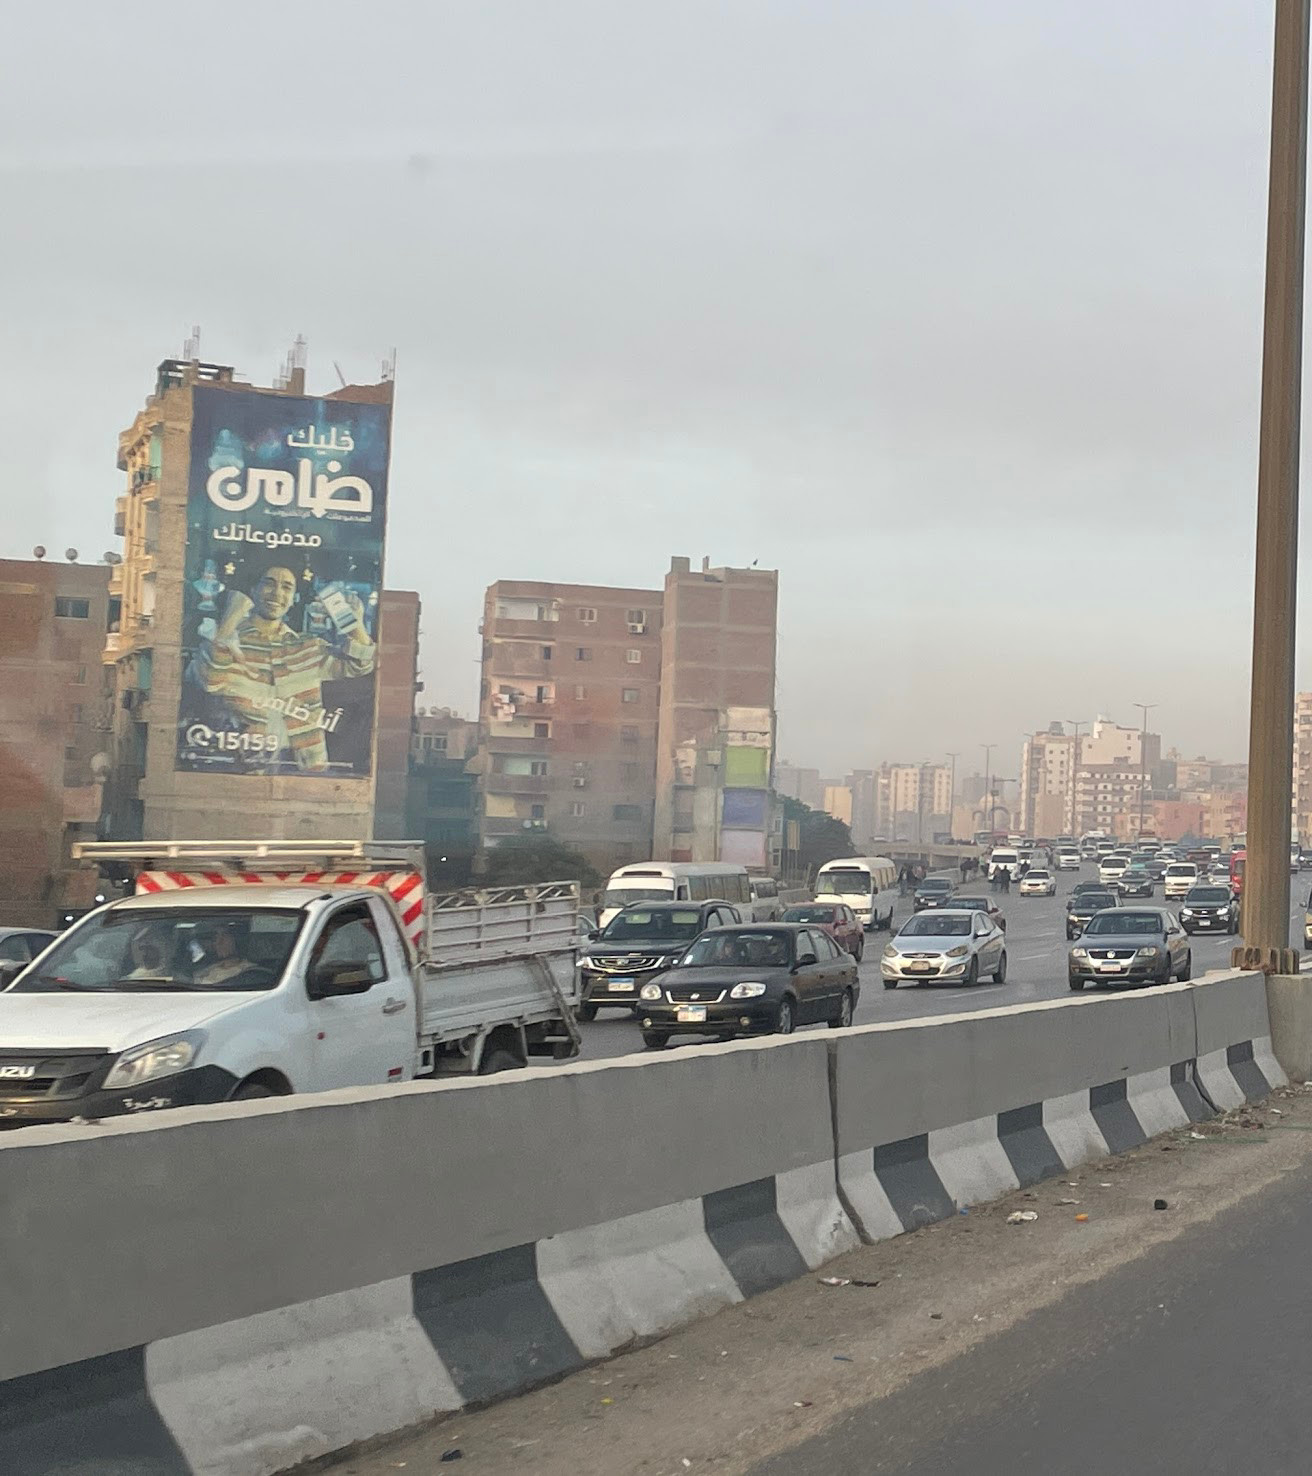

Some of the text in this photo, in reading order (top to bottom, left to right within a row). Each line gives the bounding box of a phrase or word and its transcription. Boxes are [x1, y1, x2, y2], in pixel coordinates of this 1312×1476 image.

[287, 424, 355, 455] خليك
[206, 458, 373, 518] ضامن
[213, 522, 322, 549] مدفوعاتك
[316, 707, 344, 733] أنا
[215, 731, 279, 752] 15159
